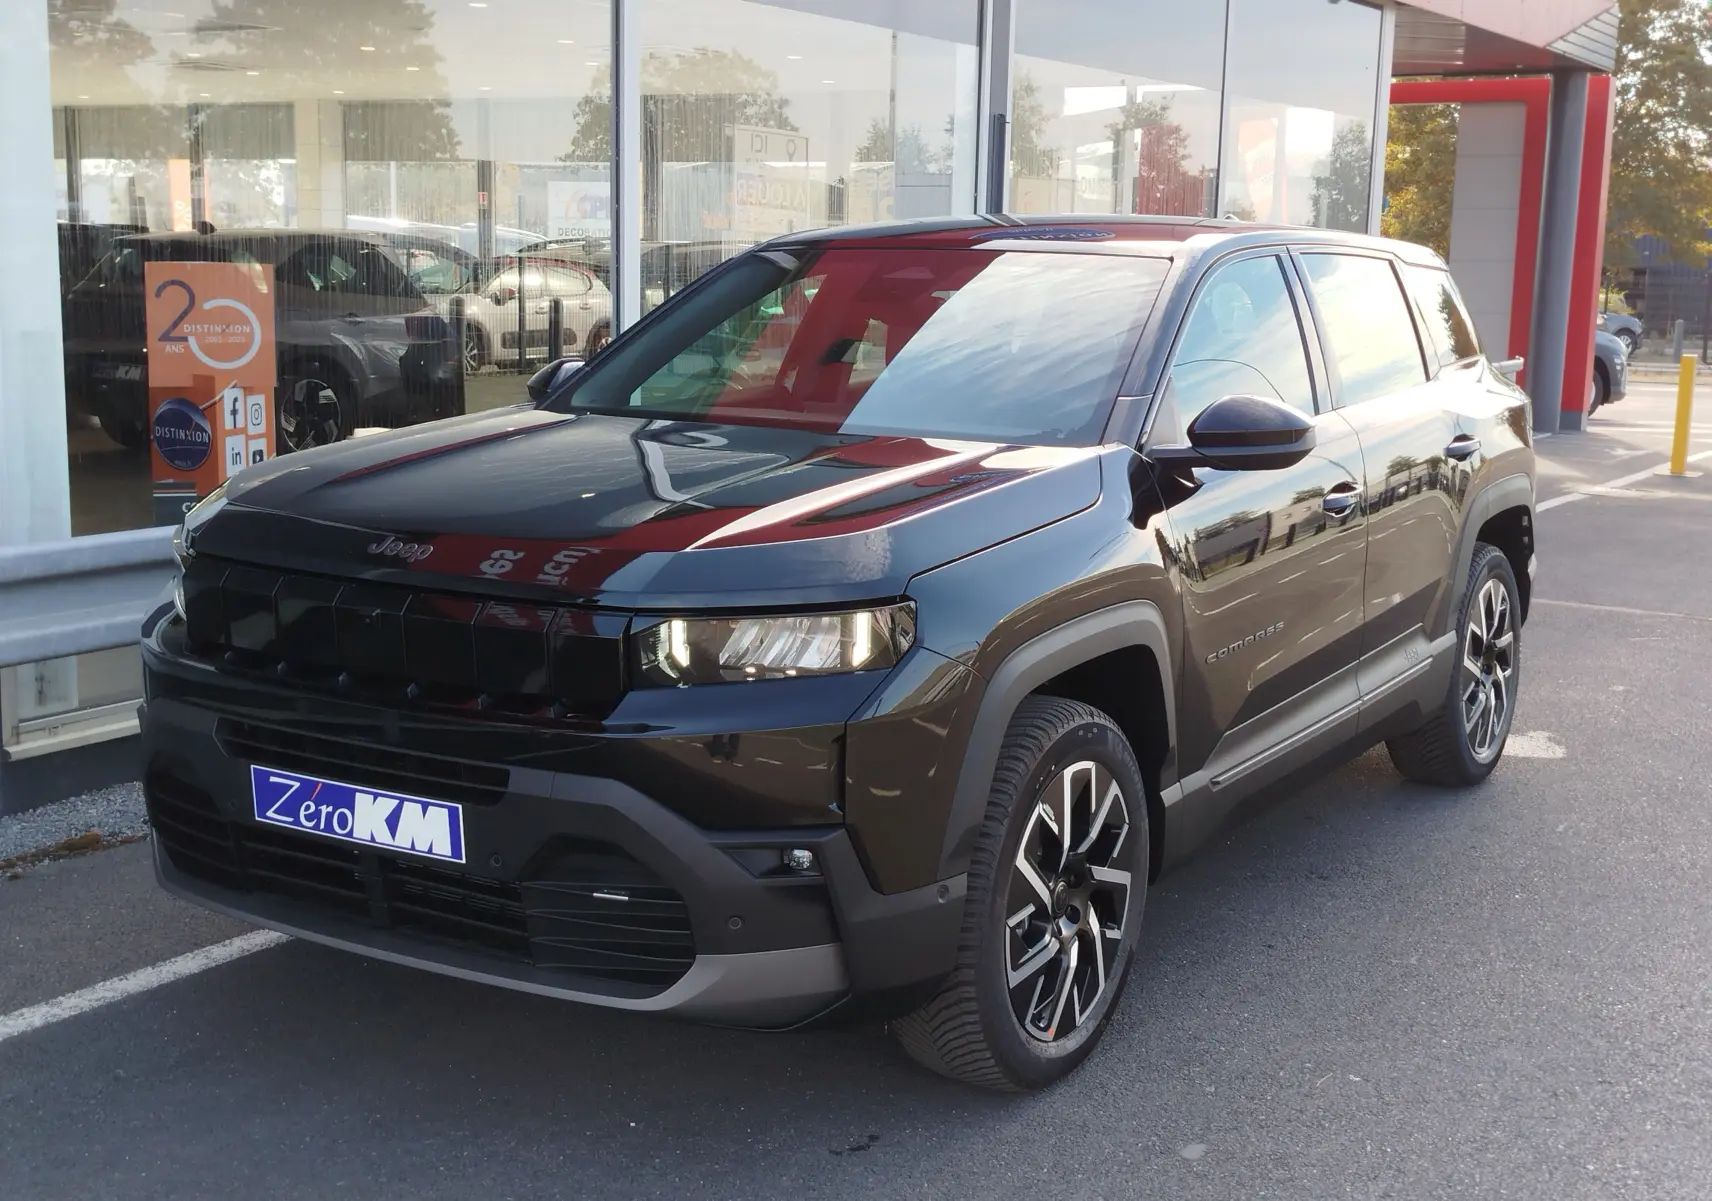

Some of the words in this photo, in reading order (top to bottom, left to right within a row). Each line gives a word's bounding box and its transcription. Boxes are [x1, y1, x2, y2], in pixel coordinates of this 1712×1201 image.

[183, 323, 251, 334] DISTINXION
[165, 344, 185, 354] ANS
[155, 426, 209, 443] DISTINXION
[366, 536, 434, 563] Jeep
[1204, 621, 1284, 665] COMPASS
